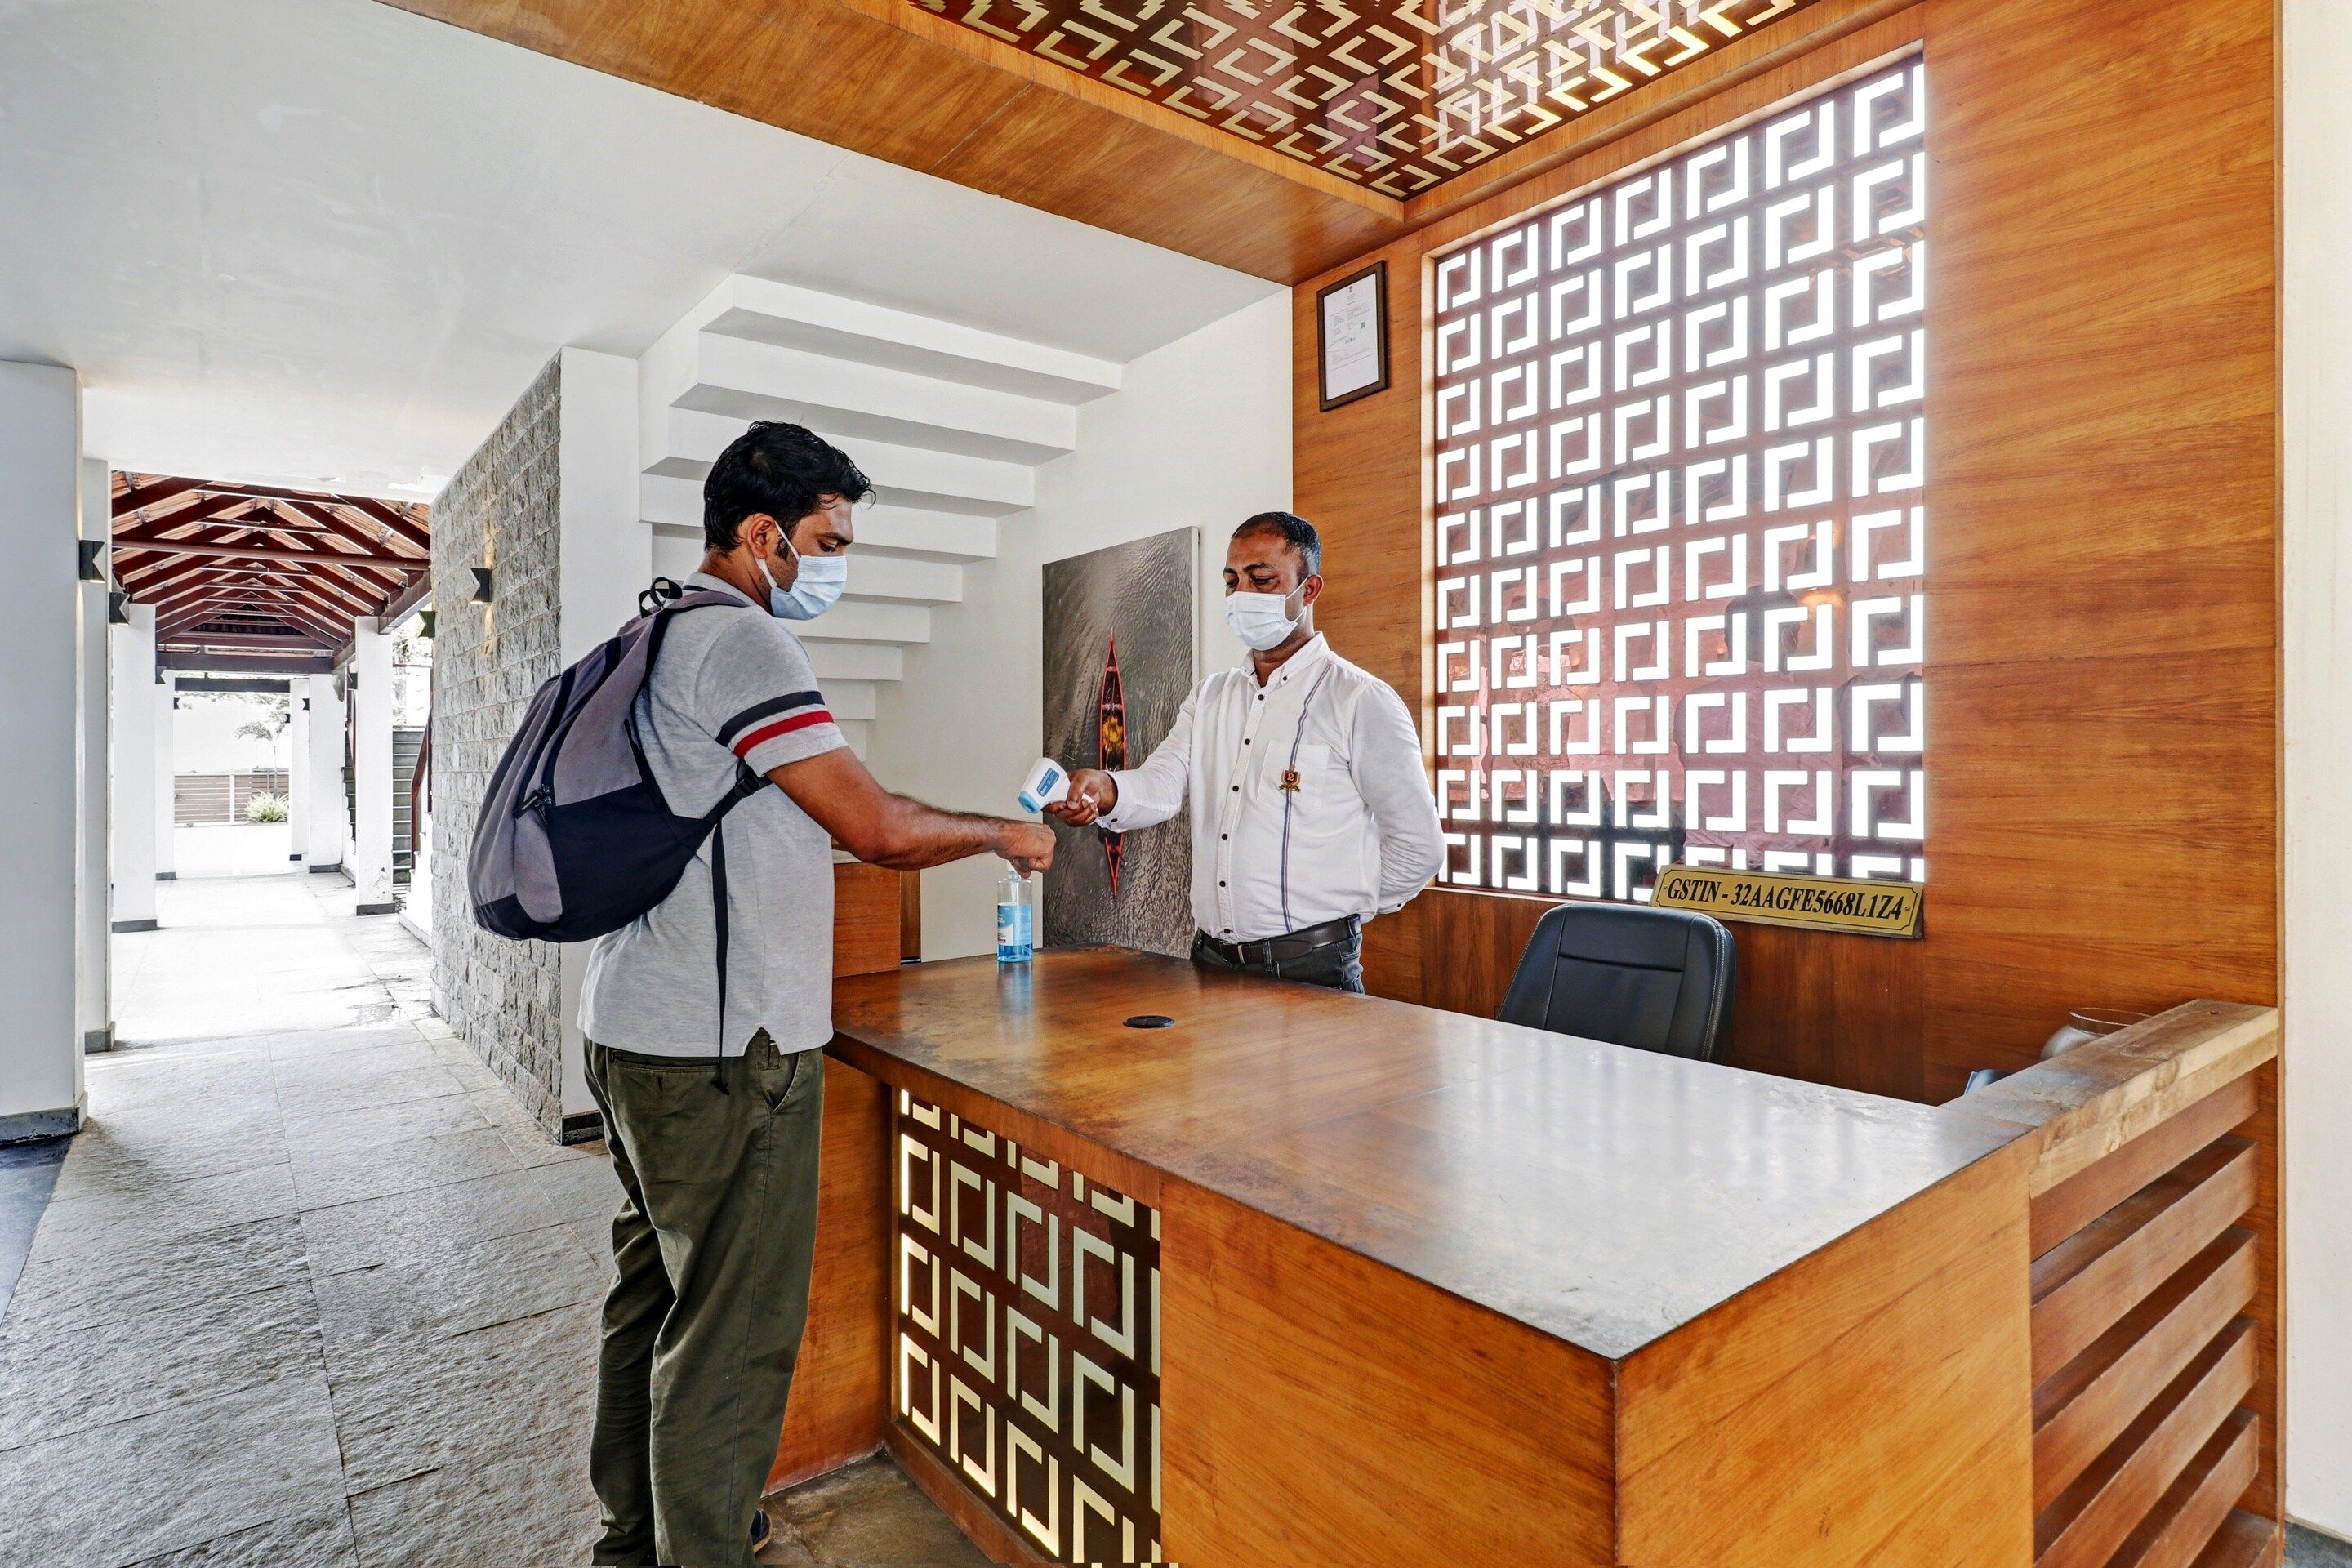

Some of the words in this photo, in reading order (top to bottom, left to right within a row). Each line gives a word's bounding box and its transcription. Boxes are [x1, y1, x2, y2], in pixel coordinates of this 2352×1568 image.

[1286, 773, 1295, 782] 2
[1667, 877, 1722, 903] GSTIN
[1731, 882, 1904, 920] 32AAGFE5668L1Z4
